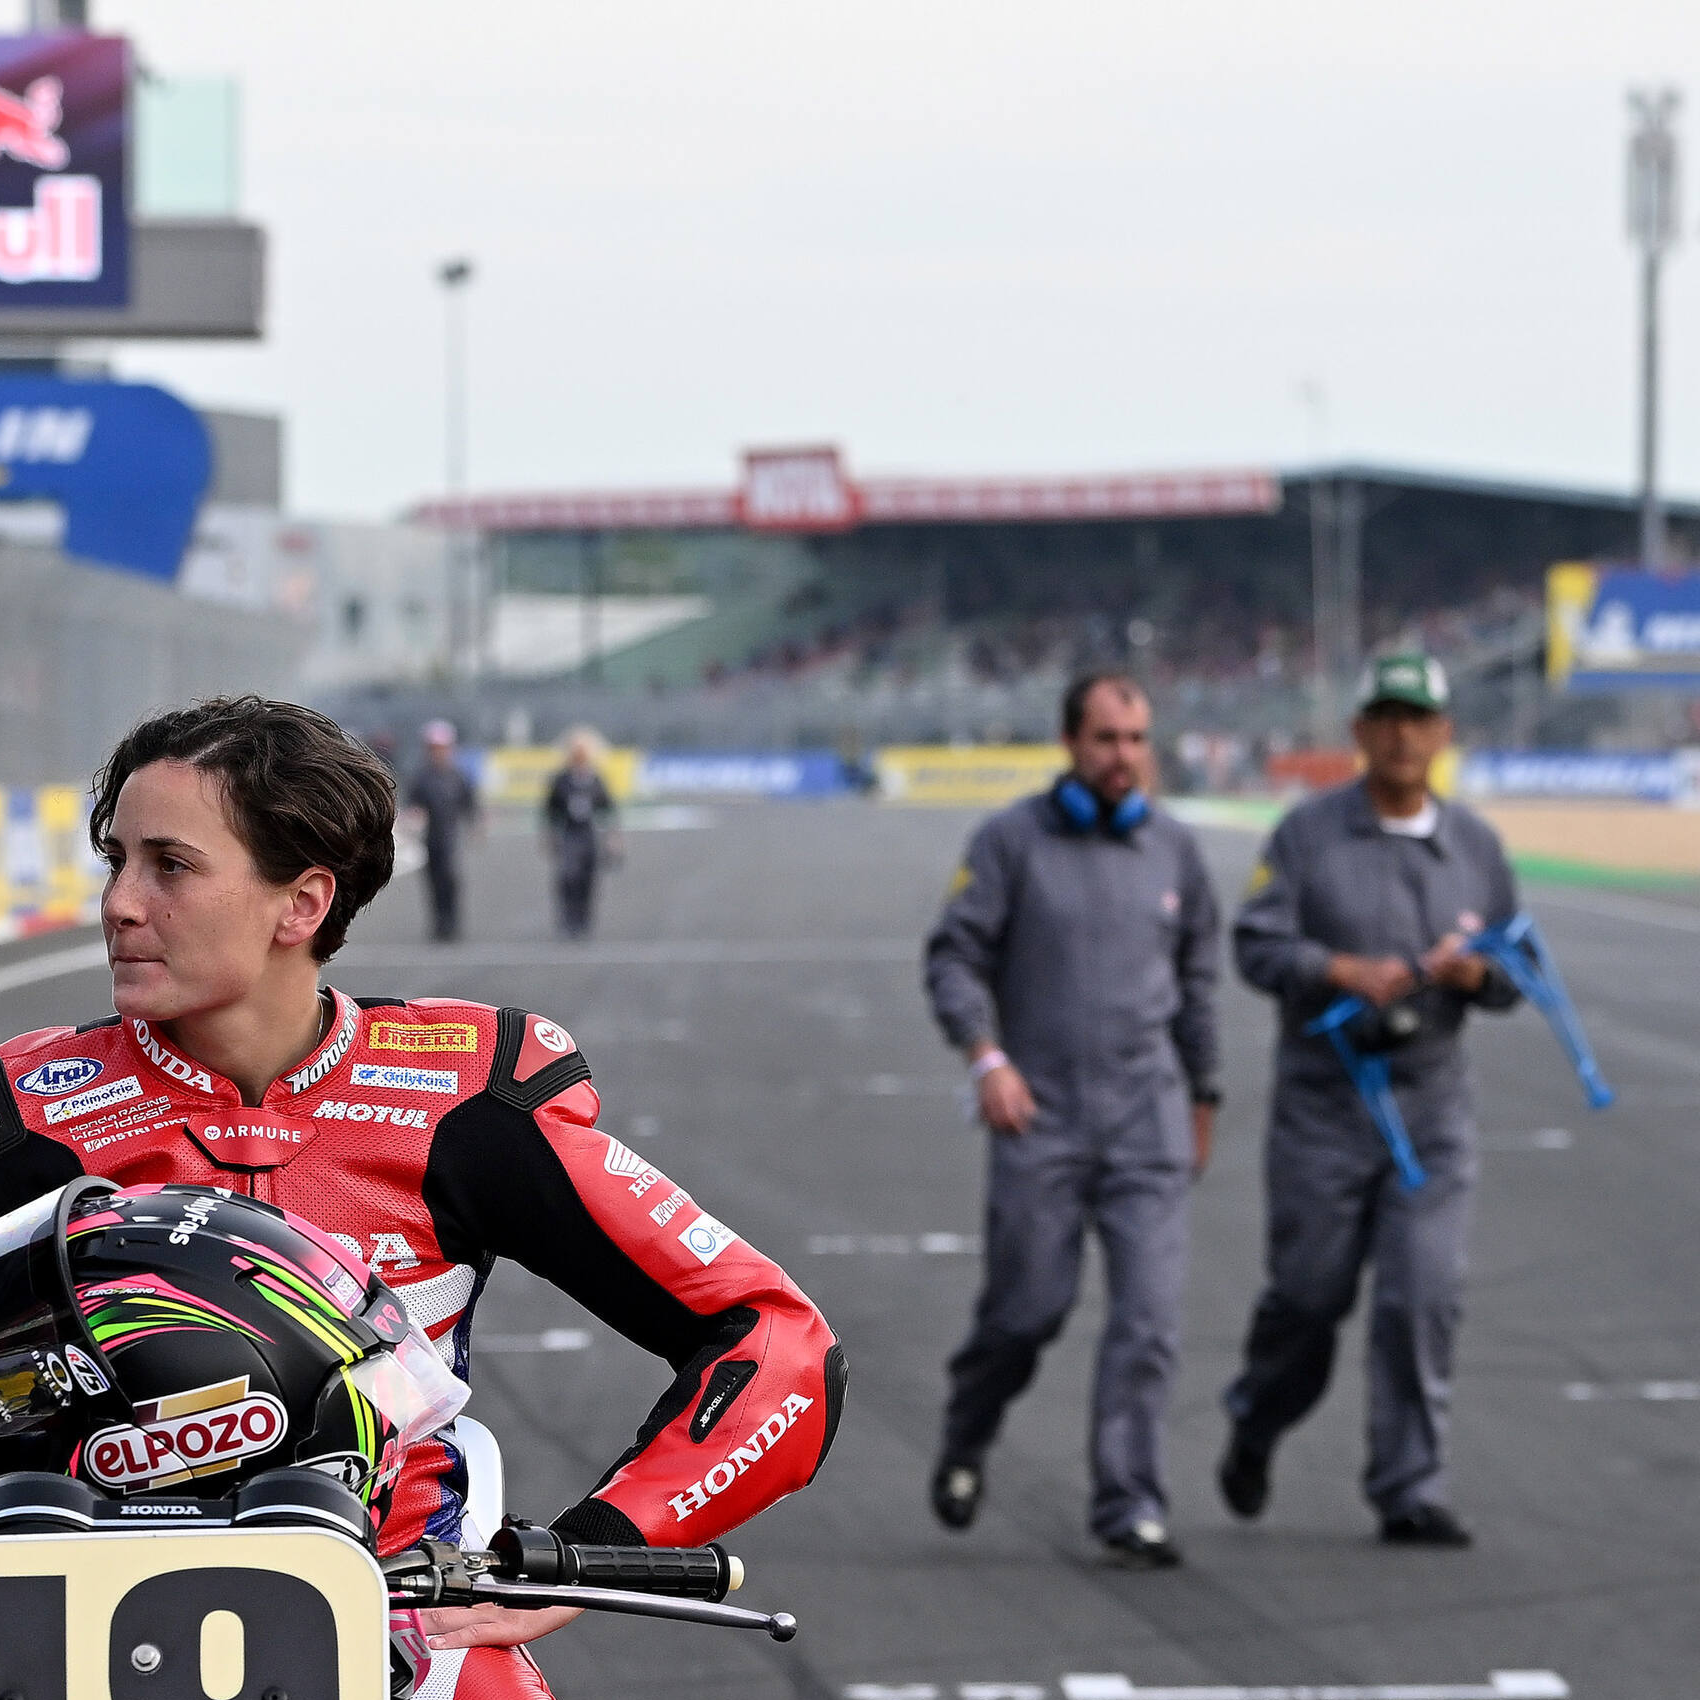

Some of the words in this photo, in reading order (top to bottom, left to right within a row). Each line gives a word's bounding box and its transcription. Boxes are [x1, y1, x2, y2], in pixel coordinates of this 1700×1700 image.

[377, 1025, 468, 1048] PIRELLI
[132, 1018, 214, 1095] ONDA
[29, 1060, 94, 1089] Arai
[383, 1070, 452, 1089] OnlyFans
[118, 1095, 170, 1118] RACING
[312, 1100, 429, 1129] MOTUL
[101, 1126, 151, 1147] DISTRI
[152, 1116, 189, 1130] BIKE
[223, 1125, 301, 1144] ARMURE
[666, 1392, 815, 1523] HONDA
[120, 1504, 202, 1516] HONDA
